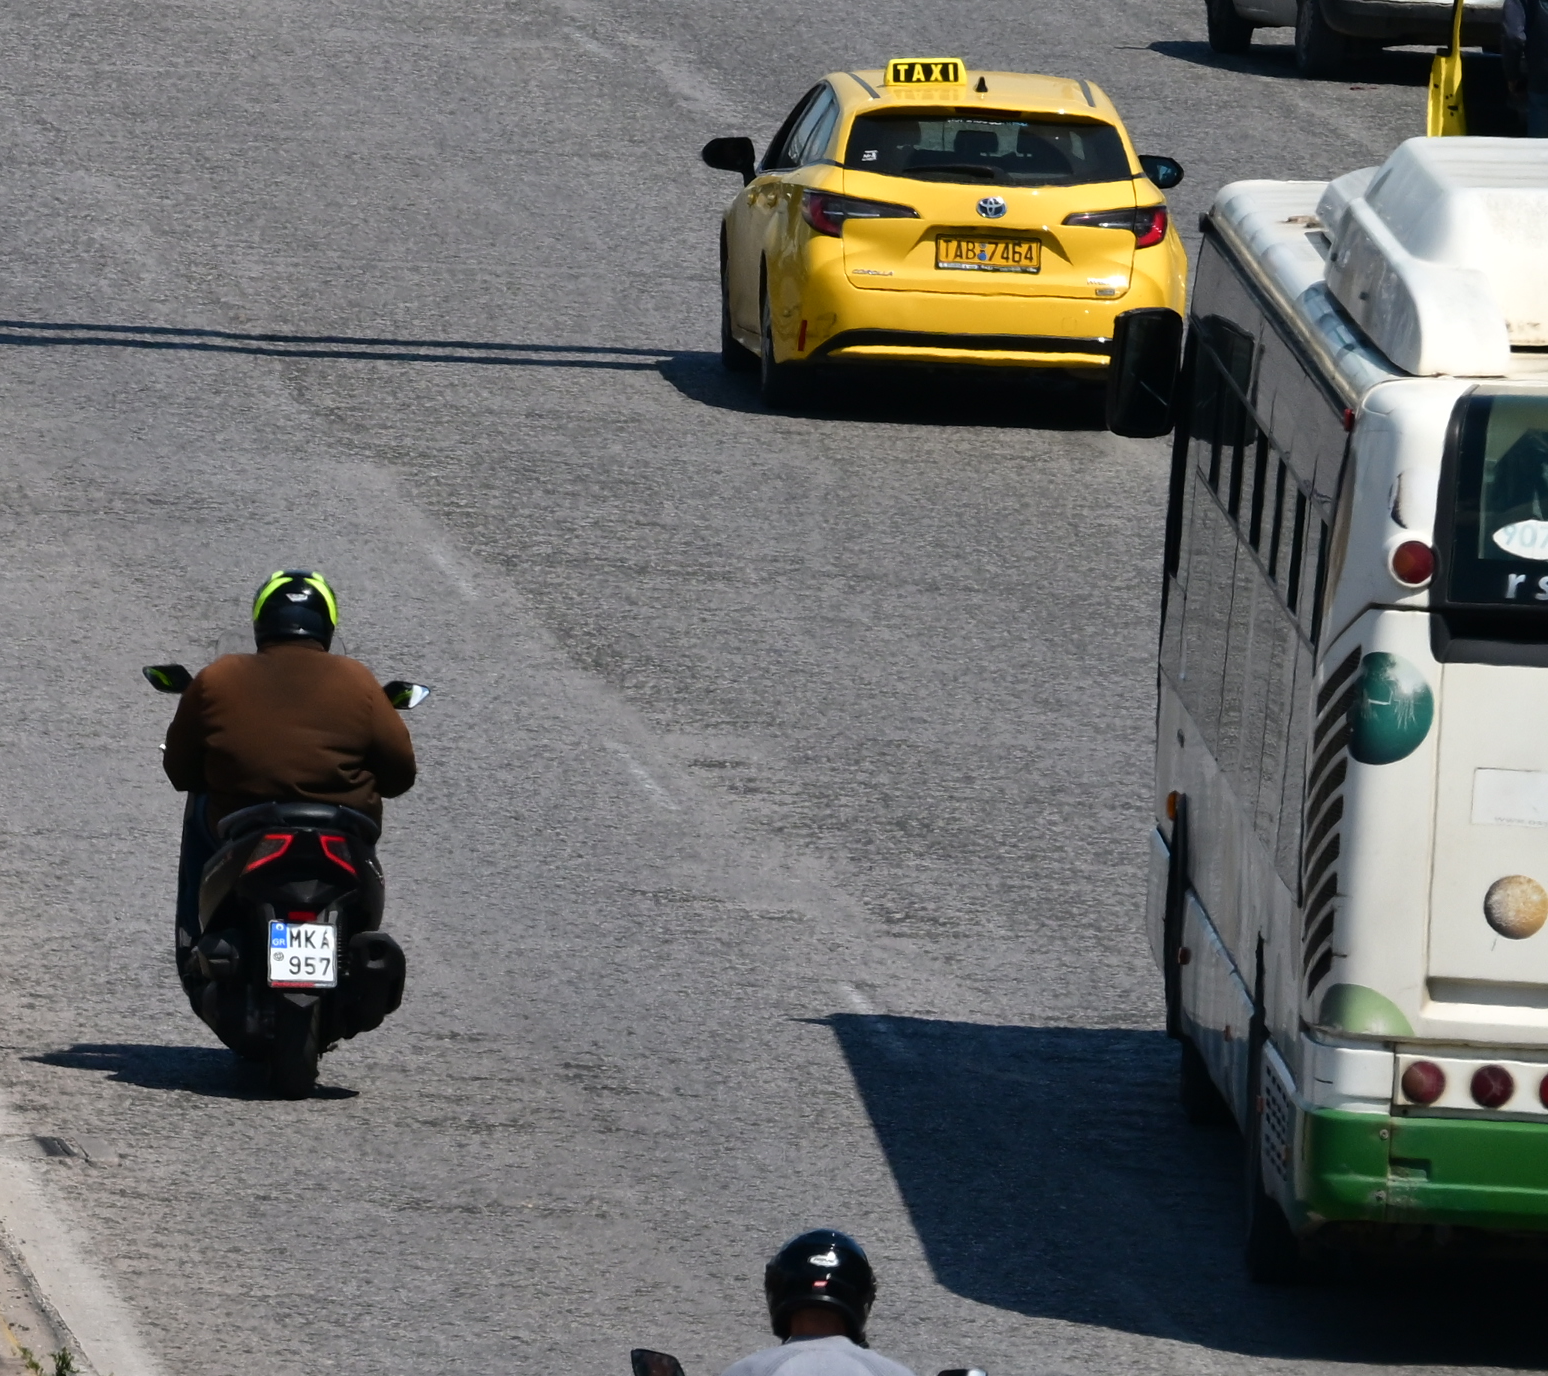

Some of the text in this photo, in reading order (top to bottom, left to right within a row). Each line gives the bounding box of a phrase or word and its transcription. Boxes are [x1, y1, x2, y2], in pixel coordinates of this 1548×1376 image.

[892, 64, 958, 84] TAXI
[939, 238, 1036, 266] TAB-7464
[272, 938, 286, 946] GR
[288, 955, 331, 976] 957
